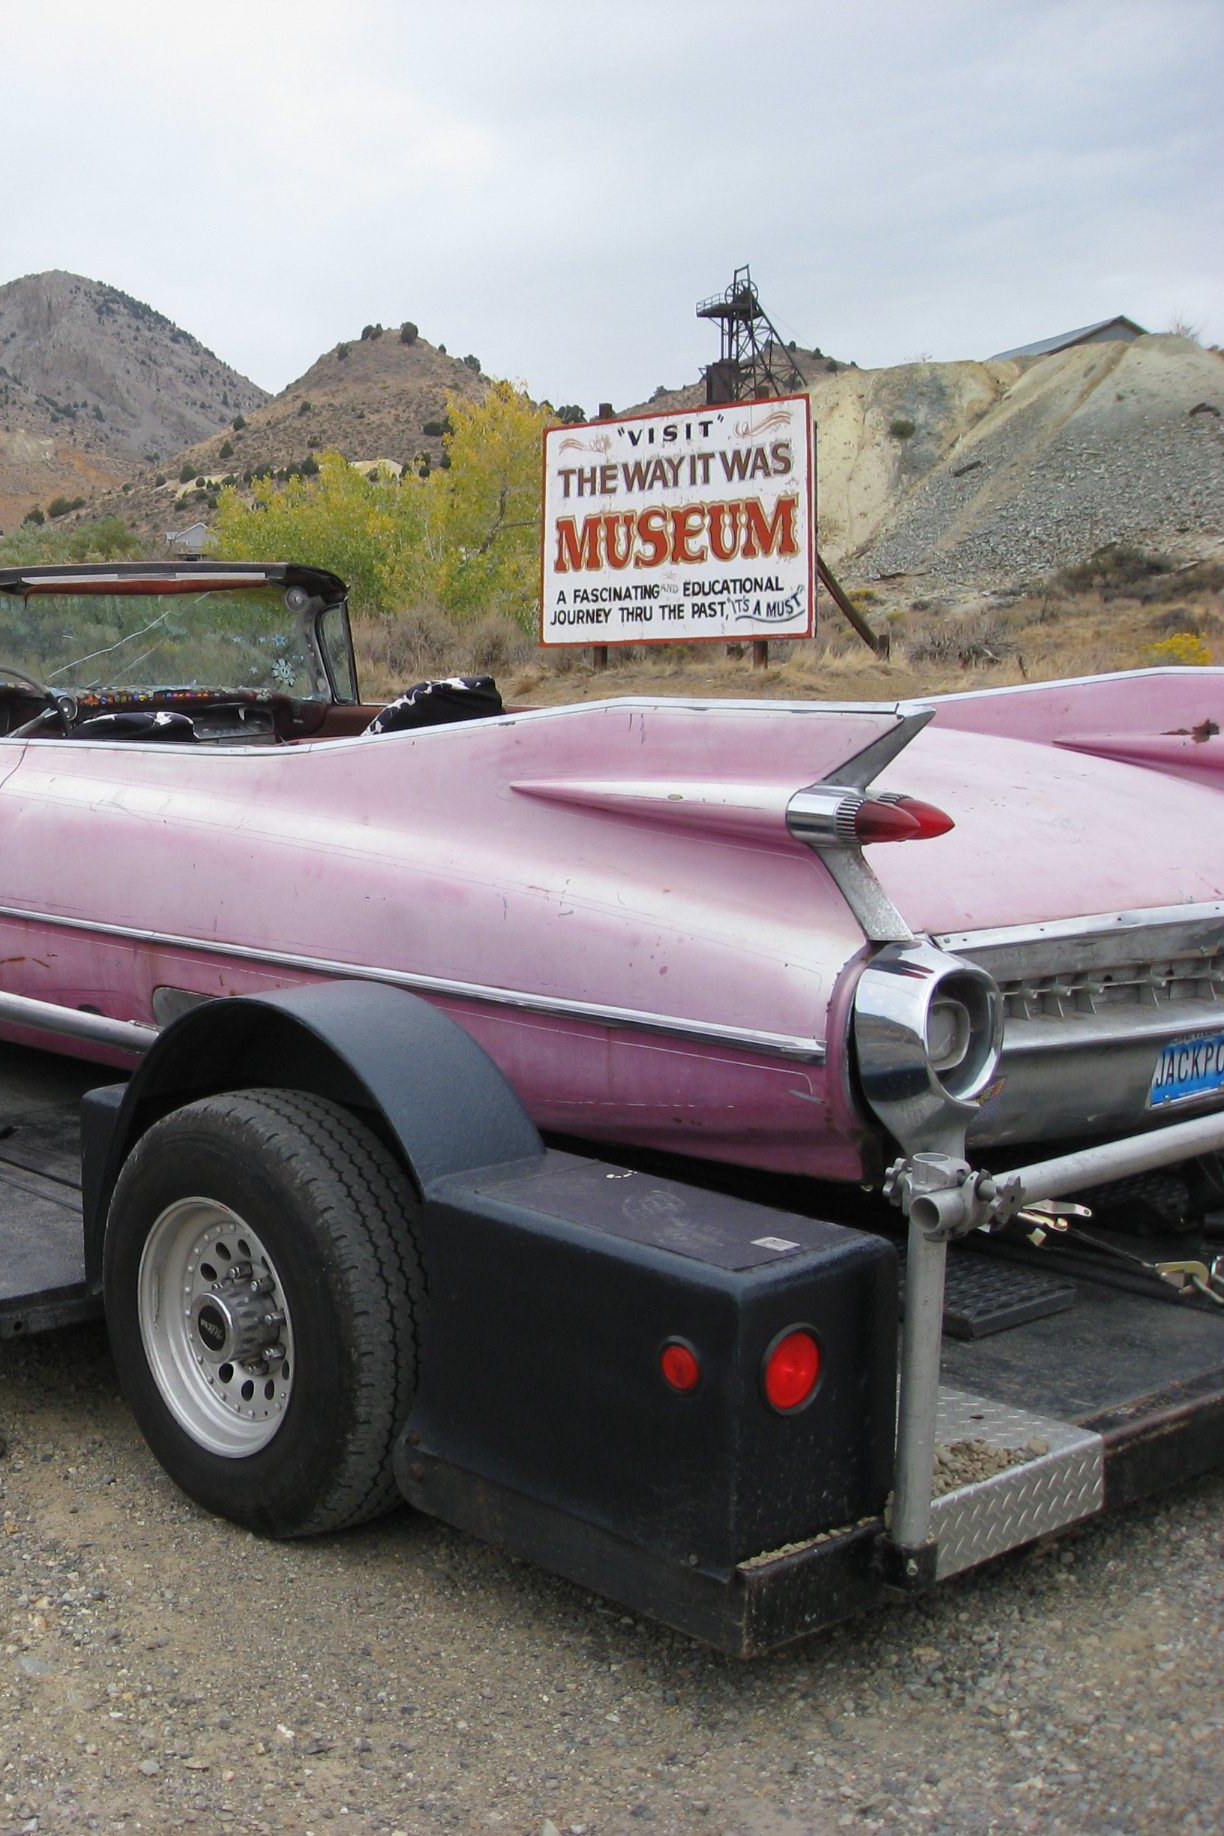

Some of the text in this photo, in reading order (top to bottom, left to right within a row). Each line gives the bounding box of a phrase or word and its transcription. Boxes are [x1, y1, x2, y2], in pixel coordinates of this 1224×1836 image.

[558, 443, 792, 498] THE WAY IT WAS
[554, 493, 799, 573] MUSEUM
[556, 590, 567, 605] A
[573, 584, 661, 604] FASCINATING
[683, 576, 784, 597] EDUCATIONAL
[550, 608, 612, 625] JOURNEY
[619, 605, 653, 623] THRU
[659, 603, 685, 620] THE
[753, 599, 761, 616] A
